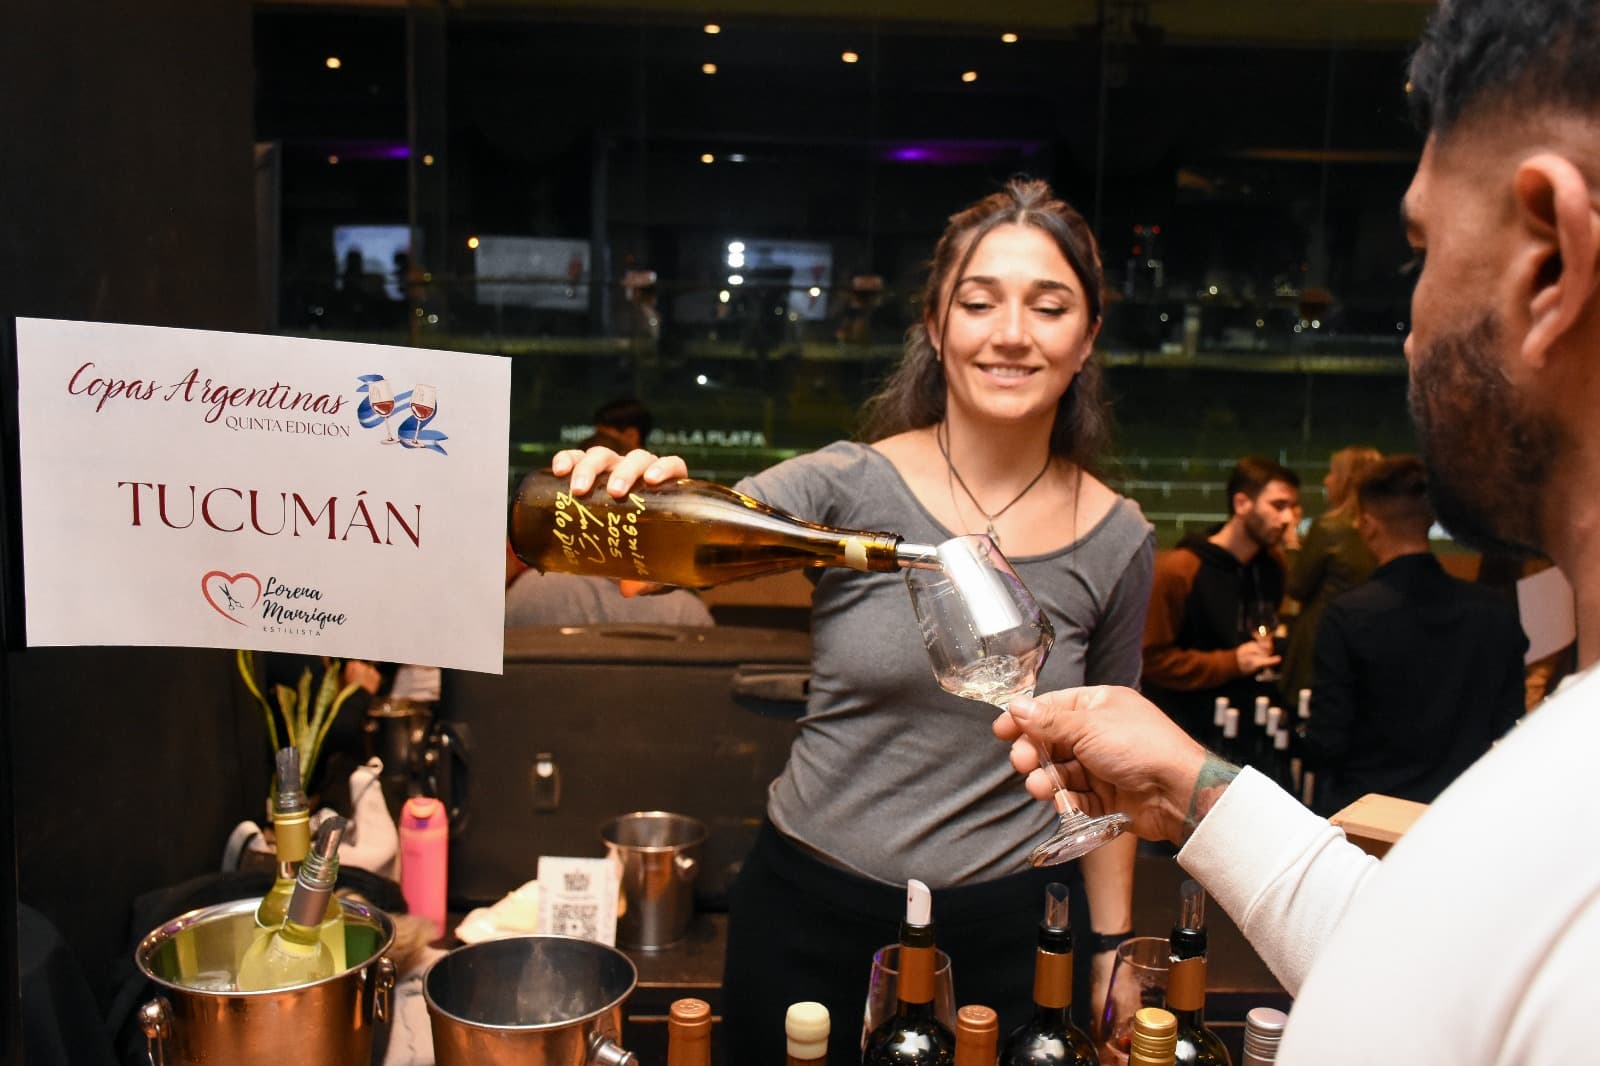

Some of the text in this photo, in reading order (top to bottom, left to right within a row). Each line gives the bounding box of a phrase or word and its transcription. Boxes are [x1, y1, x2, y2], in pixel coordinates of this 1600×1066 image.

[67, 361, 350, 424] Copas Argentinas
[225, 415, 352, 438] QUINTA EDICIÓN
[706, 430, 767, 447] PLATA
[118, 481, 422, 548] TUCUMÁN
[607, 512, 622, 558] 2025
[263, 576, 323, 601] Lorena
[262, 599, 348, 630] Manrique
[263, 627, 321, 636] ESTILISTA
